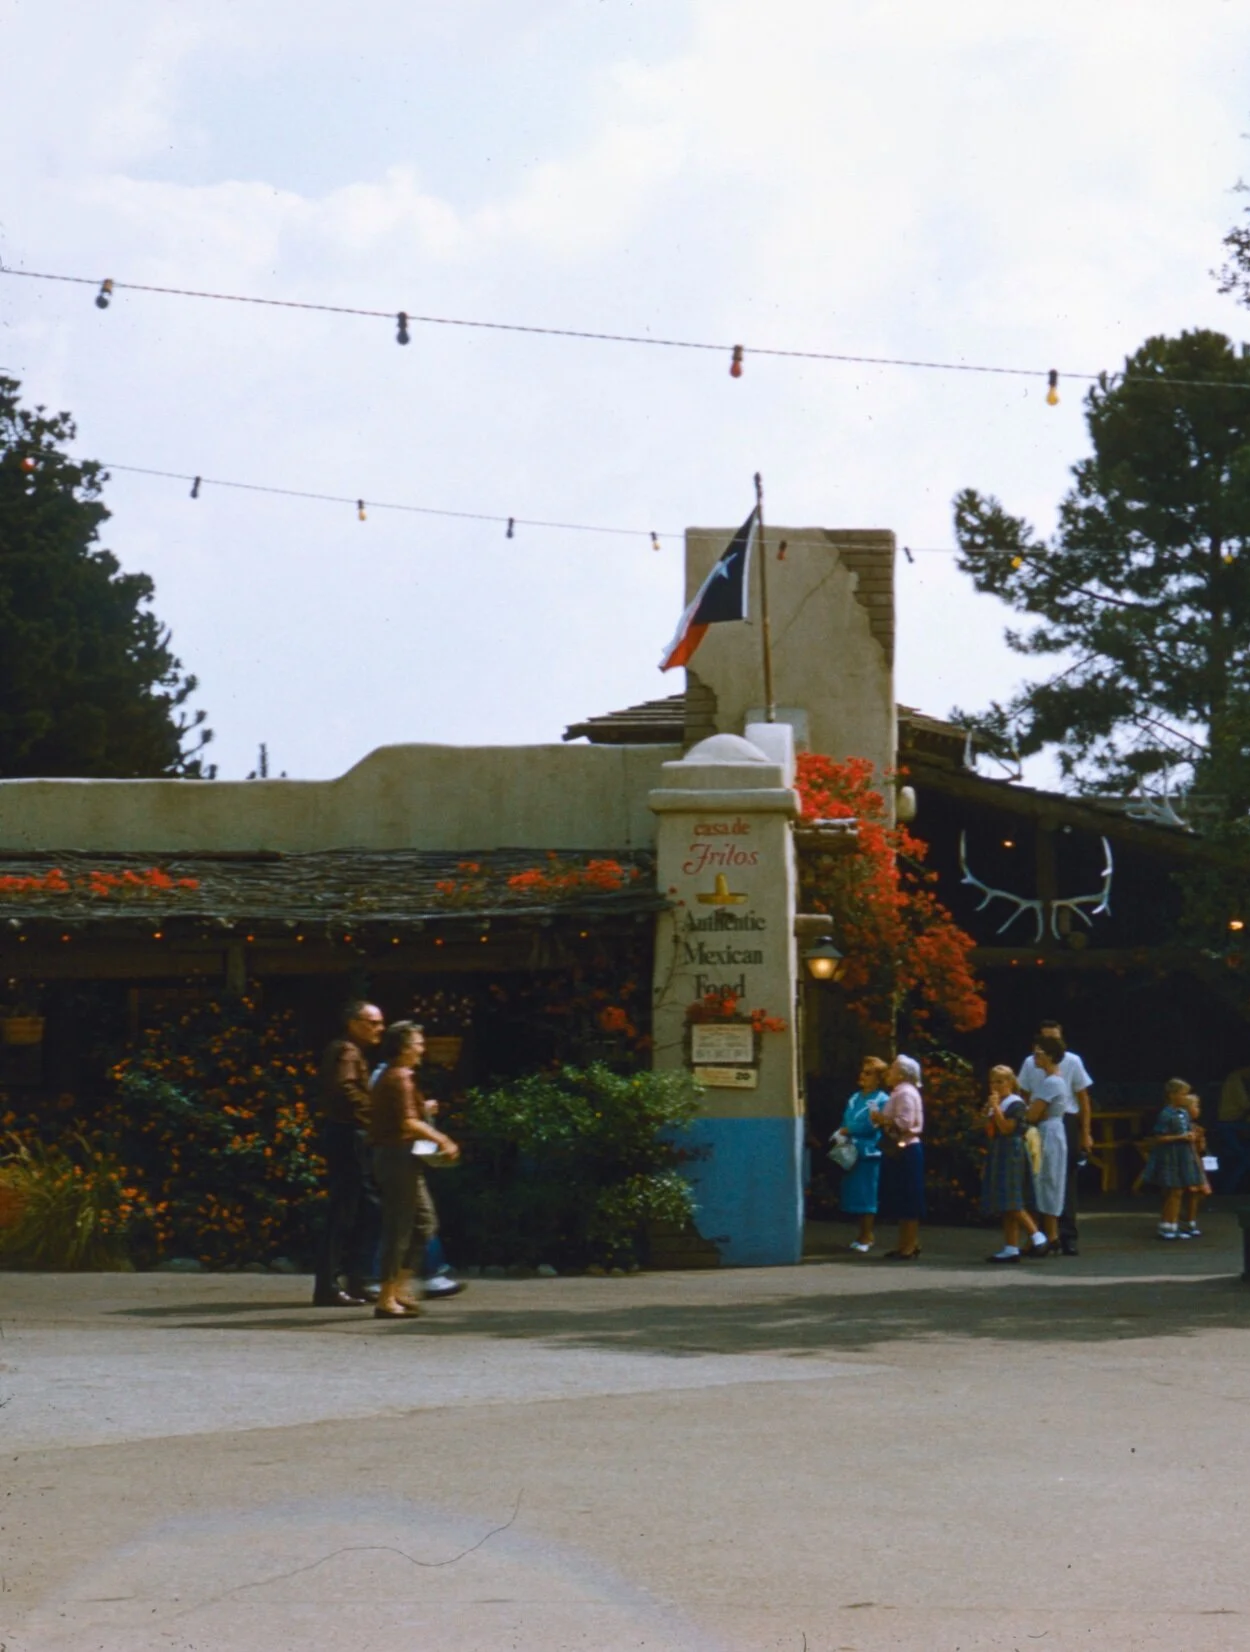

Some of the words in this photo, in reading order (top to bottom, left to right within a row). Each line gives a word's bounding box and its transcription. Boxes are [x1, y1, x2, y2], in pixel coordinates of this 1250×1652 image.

[731, 817, 751, 836] de
[682, 843, 759, 875] Fritos
[682, 909, 766, 932] Authentic
[684, 941, 764, 966] Mexican
[694, 973, 746, 999] Food
